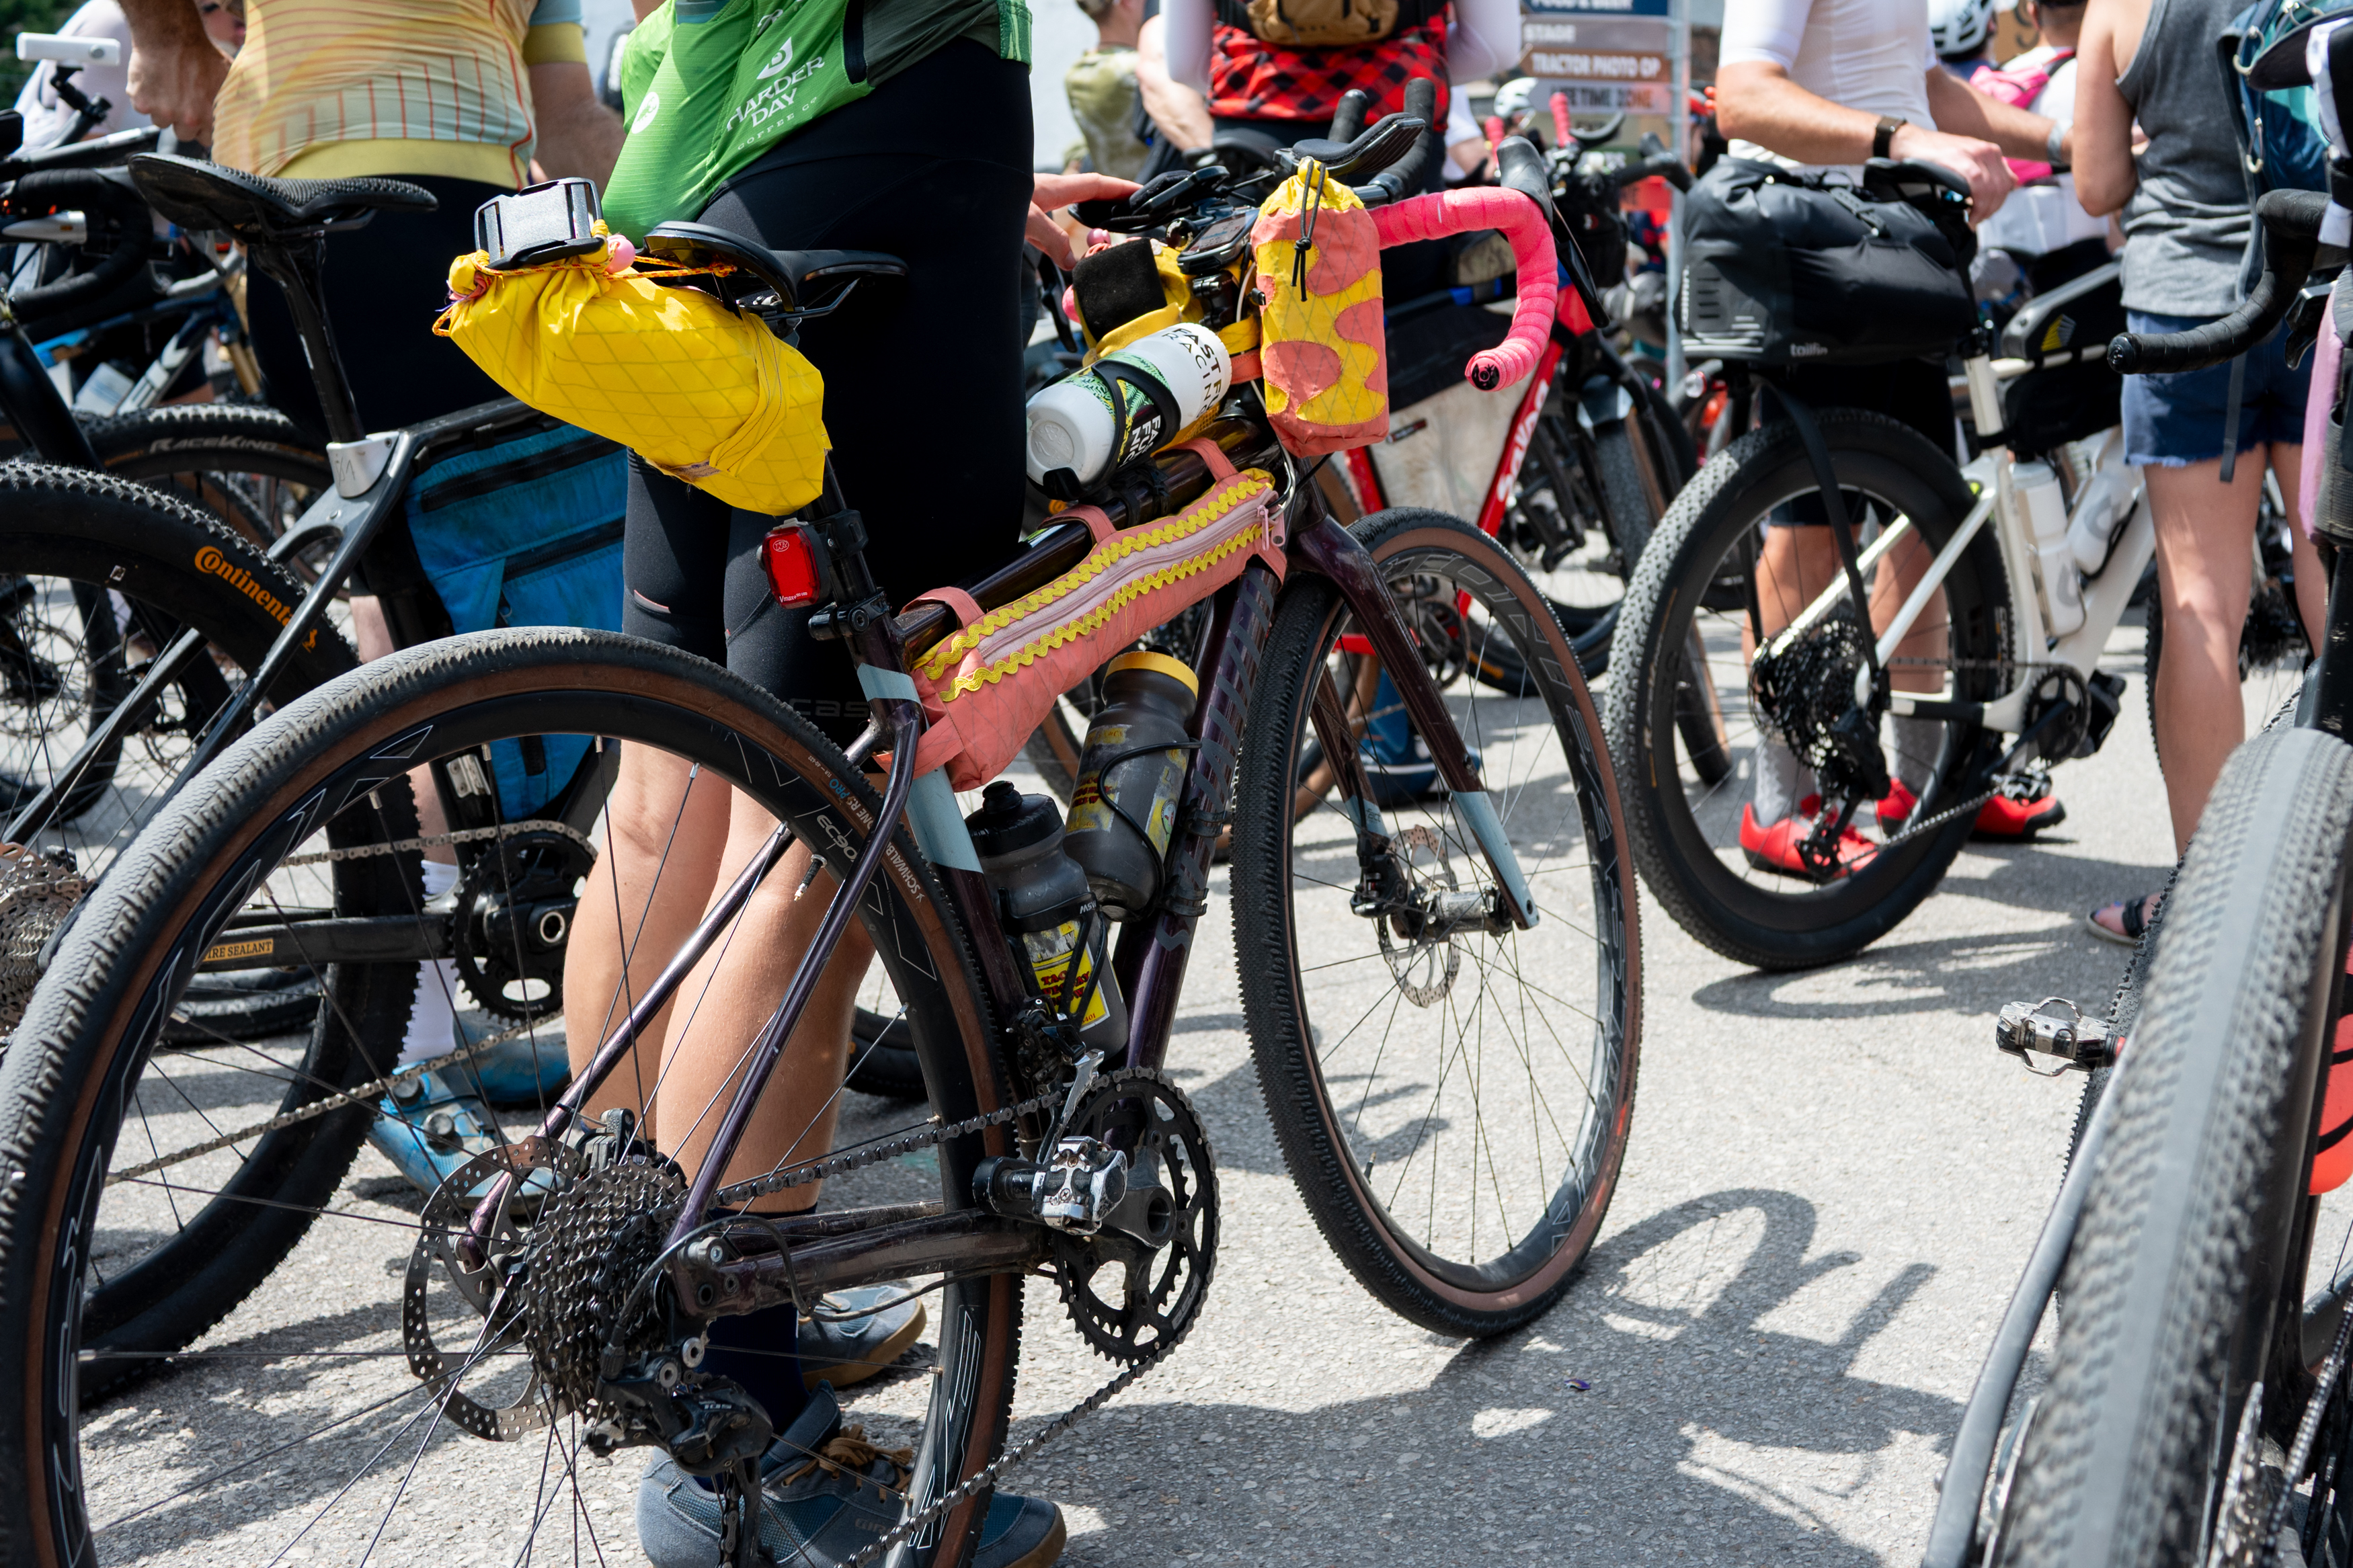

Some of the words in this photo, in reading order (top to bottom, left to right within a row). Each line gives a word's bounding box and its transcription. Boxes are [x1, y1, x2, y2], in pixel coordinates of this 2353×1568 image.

[1523, 24, 1576, 42] STAGE
[1531, 52, 1591, 74] TRACTOR
[1593, 55, 1638, 77] PHOTO
[1640, 57, 1661, 78] OP
[751, 87, 797, 127] DAY
[738, 113, 794, 151] COFFEE
[1172, 328, 1222, 373] FAST
[1790, 342, 1828, 357] tailfin
[1121, 426, 1142, 467] NIC
[194, 546, 294, 626] Continenta
[829, 778, 849, 800] PRO
[817, 815, 857, 863] EC90
[885, 842, 921, 895] SCHWALB
[1080, 899, 1097, 914] MSW
[204, 946, 226, 960] IRE
[227, 941, 272, 957] SEALANT
